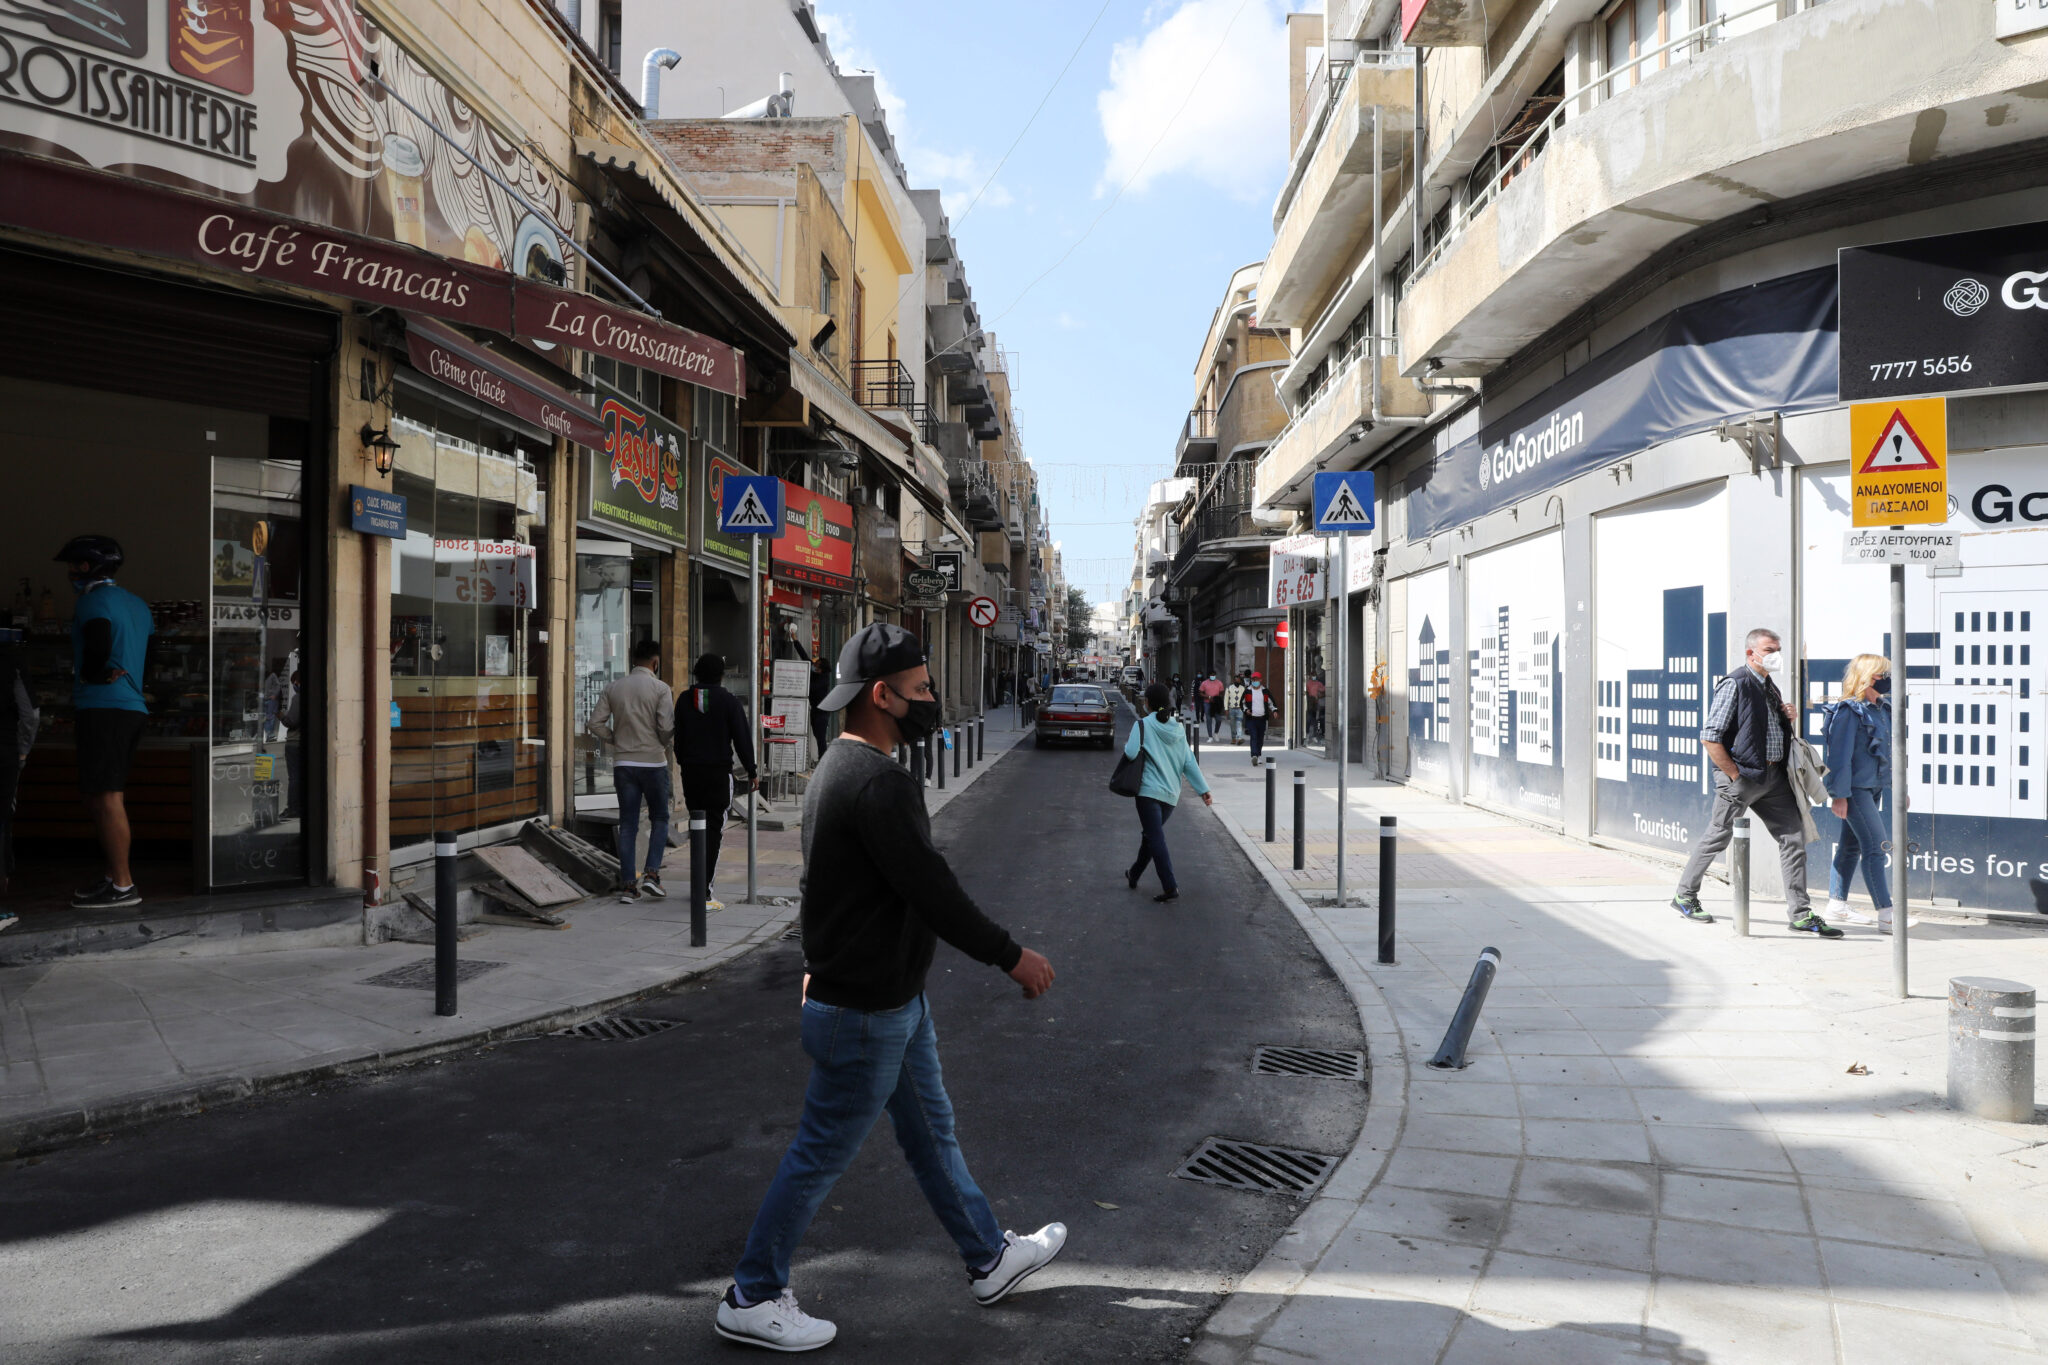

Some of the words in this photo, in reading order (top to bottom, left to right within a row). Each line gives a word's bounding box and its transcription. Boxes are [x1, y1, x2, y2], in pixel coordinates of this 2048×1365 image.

[197, 214, 298, 273] Café
[311, 240, 470, 308] Francais
[545, 301, 584, 337] La
[591, 313, 716, 378] Croissanterie
[428, 348, 467, 388] Crème
[470, 368, 507, 406] Glacée
[1870, 360, 1918, 381] 7777
[1922, 354, 1973, 377] 5656
[540, 403, 572, 436] Gaufre
[600, 398, 660, 503] Tasty
[1492, 410, 1584, 486] GoGordian
[1856, 480, 1943, 497] ΑΝΑΔΥΟΜΕΝΟΙ
[593, 499, 629, 521] ΑΥΘΕΝΤΙΚΟΣ
[786, 510, 805, 526] SHAM
[825, 523, 840, 537] FOOD
[1880, 535, 1953, 546] ΛΕΙΤΟΥΡΓΙΑΣ
[909, 573, 944, 587] Carlsberg
[1276, 579, 1287, 605] €5
[1296, 573, 1315, 602] €25
[1519, 785, 1561, 810] Commercial
[1632, 812, 1689, 844] Touristic
[1986, 854, 2028, 878] for
